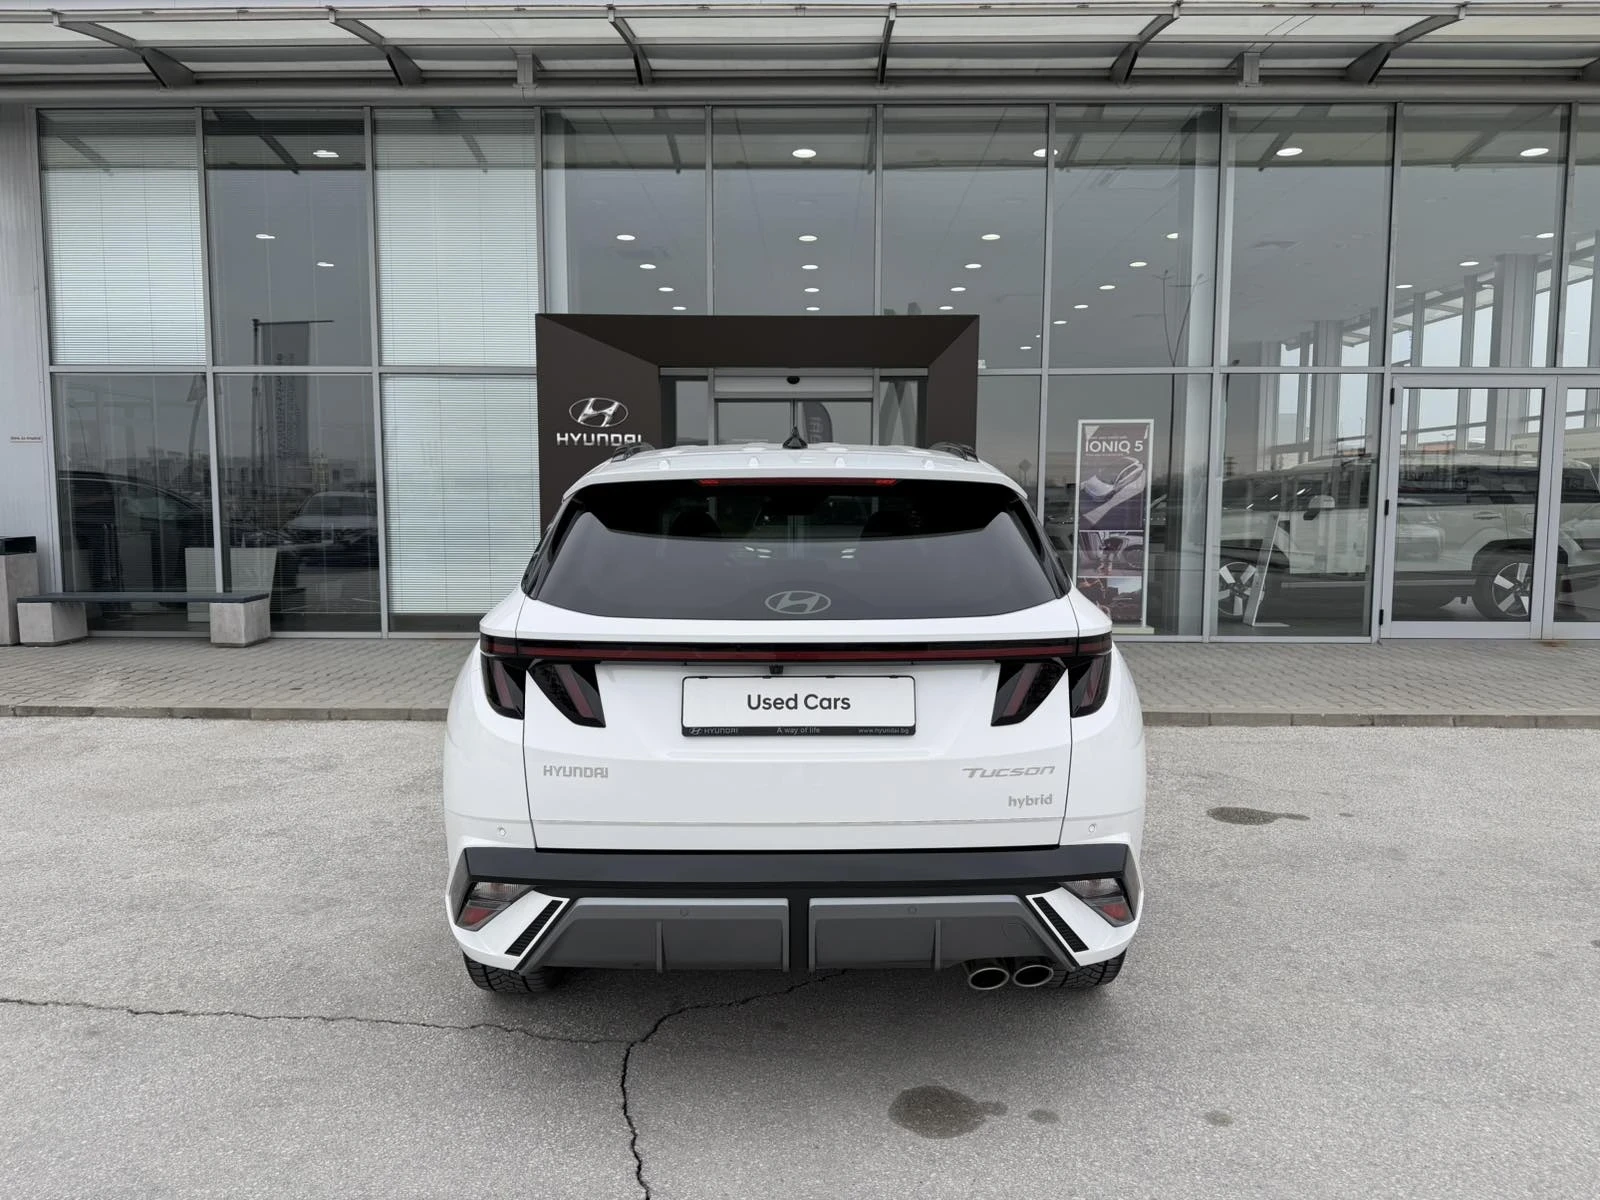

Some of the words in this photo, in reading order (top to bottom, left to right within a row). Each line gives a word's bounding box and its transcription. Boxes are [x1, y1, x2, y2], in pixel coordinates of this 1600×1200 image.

[556, 432, 642, 446] HYUNDAI
[1085, 440, 1131, 454] IONIQ
[1134, 440, 1144, 452] 5
[747, 693, 799, 710] Used
[803, 693, 851, 710] Cars
[543, 765, 609, 778] HYUNDAI
[1008, 793, 1053, 809] hybrid
